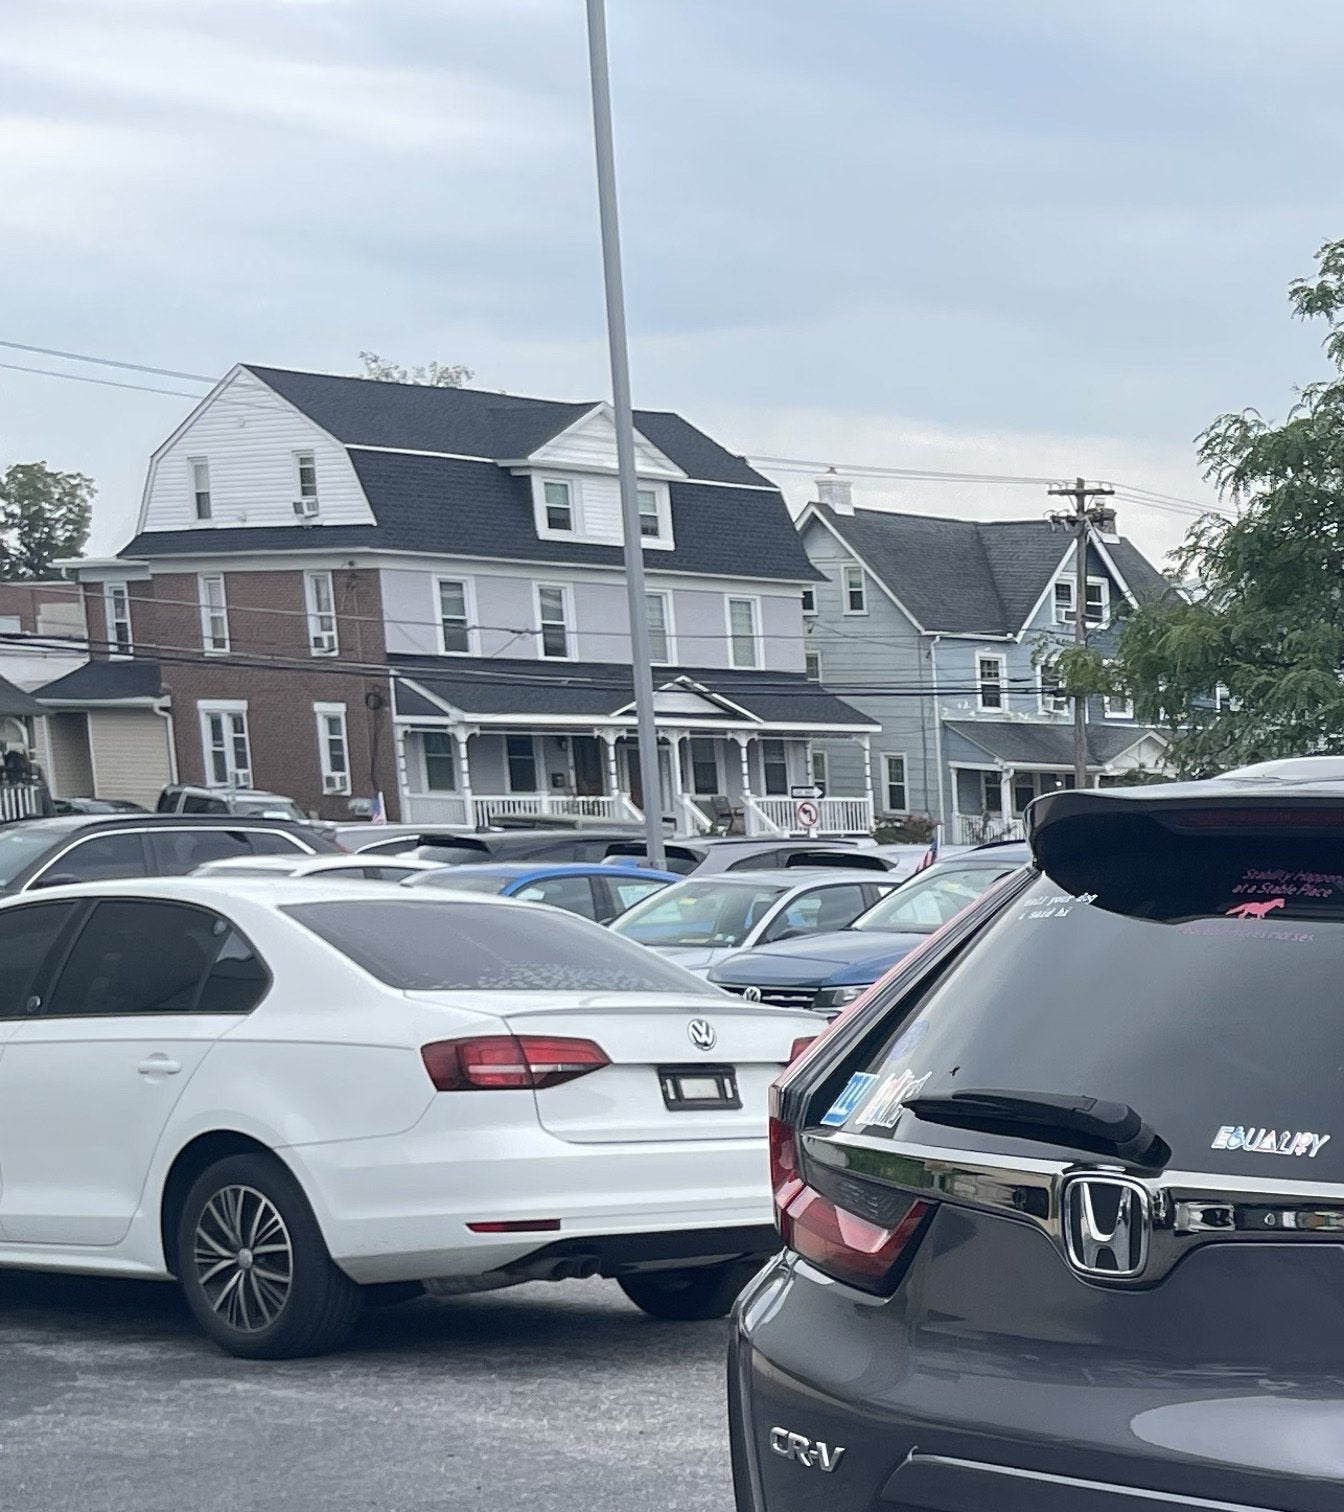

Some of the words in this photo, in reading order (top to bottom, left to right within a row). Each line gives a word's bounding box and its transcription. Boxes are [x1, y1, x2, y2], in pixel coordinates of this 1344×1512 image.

[1242, 869, 1292, 883] Stability
[1257, 882, 1297, 895] Stable
[1296, 884, 1333, 897] Place
[769, 1426, 847, 1473] CR-V
